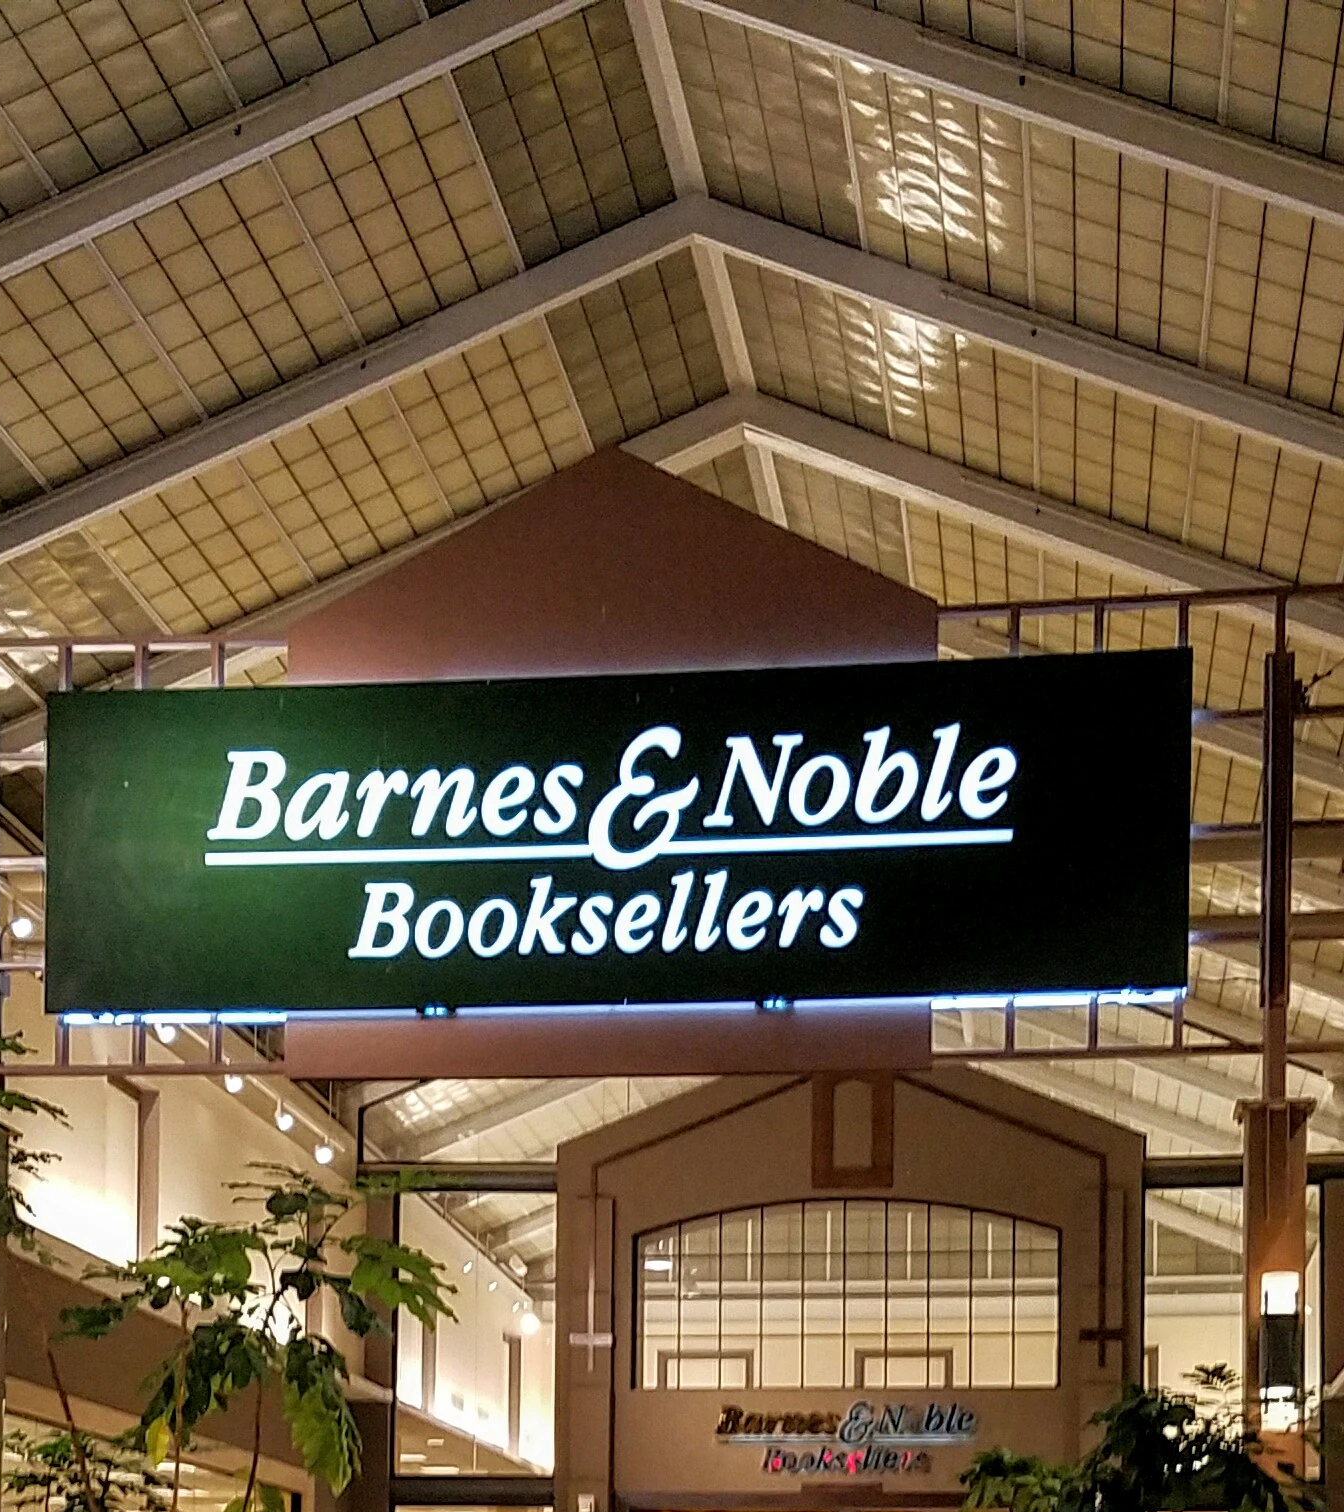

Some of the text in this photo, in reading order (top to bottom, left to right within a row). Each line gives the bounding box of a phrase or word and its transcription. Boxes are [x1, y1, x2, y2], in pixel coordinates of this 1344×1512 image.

[206, 721, 1018, 871] Barnes & Noble
[347, 867, 864, 960] Booksellers
[716, 1404, 841, 1435] Barnes
[837, 1400, 876, 1445] &
